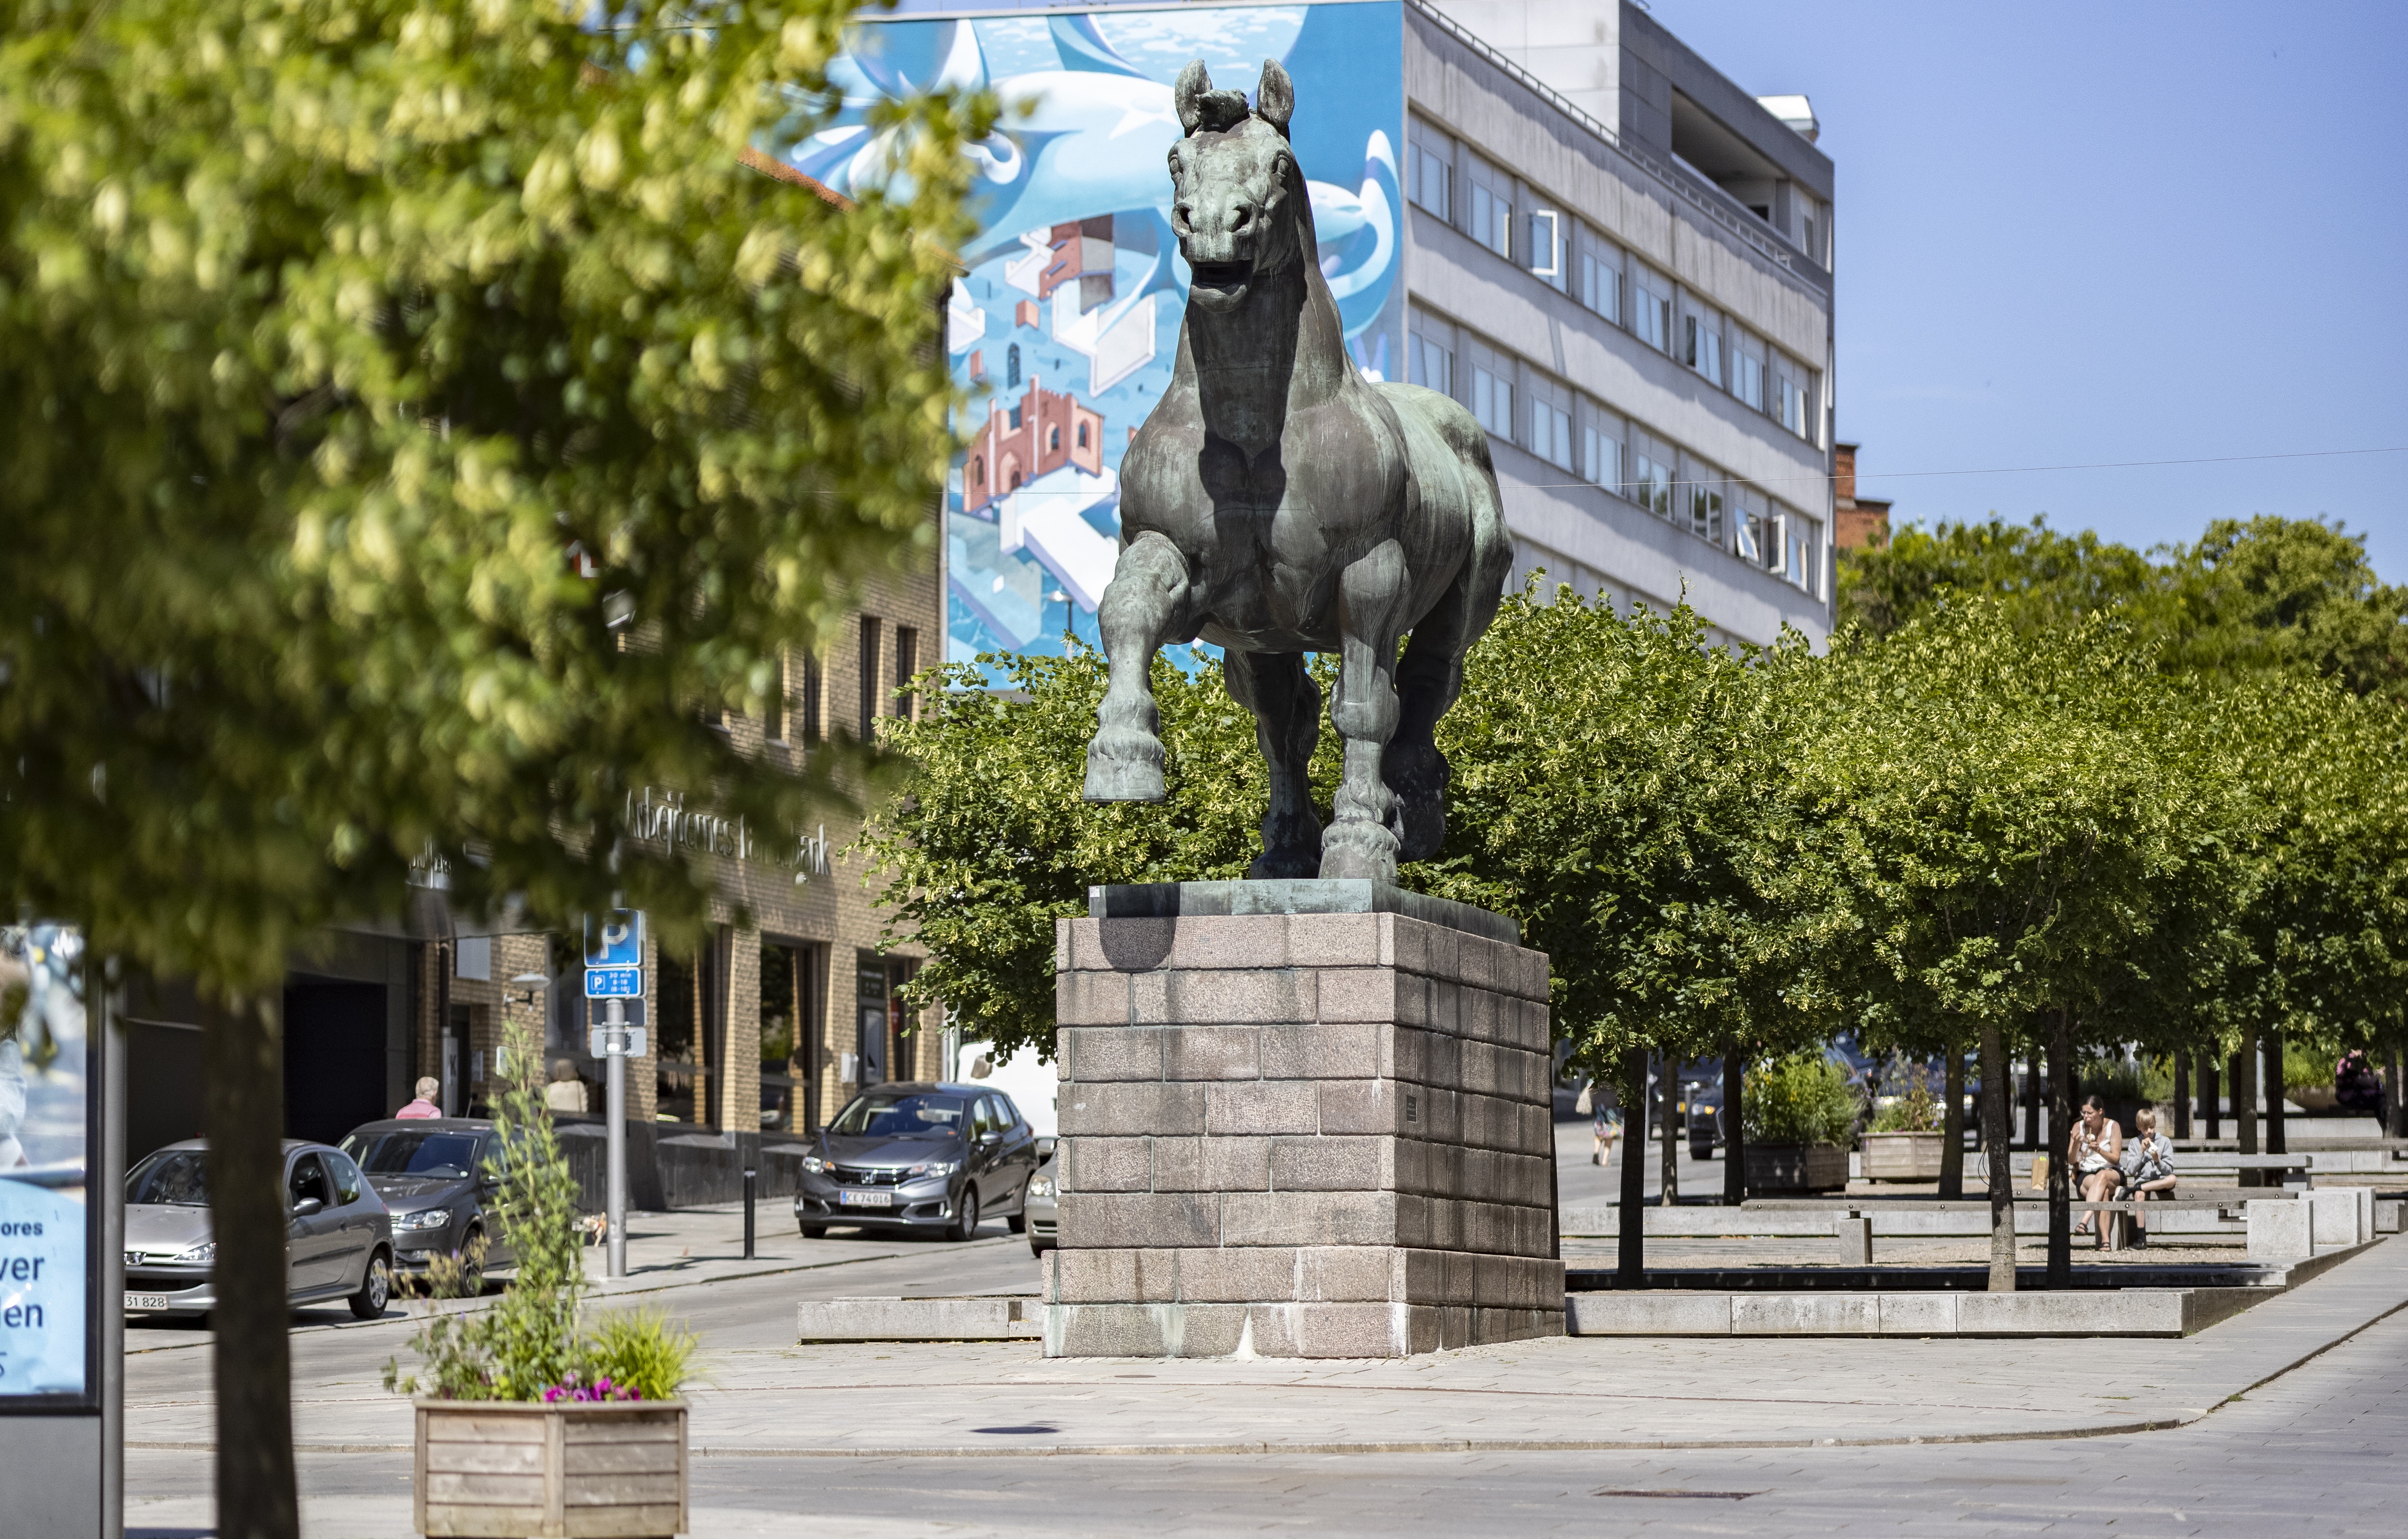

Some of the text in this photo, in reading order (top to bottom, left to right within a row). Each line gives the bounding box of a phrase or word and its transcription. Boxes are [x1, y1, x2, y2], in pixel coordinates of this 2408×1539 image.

[740, 814, 829, 875] Labank
[600, 921, 629, 960] P
[594, 976, 603, 988] P
[0, 1297, 43, 1327] en
[126, 1296, 165, 1307] 31 828
